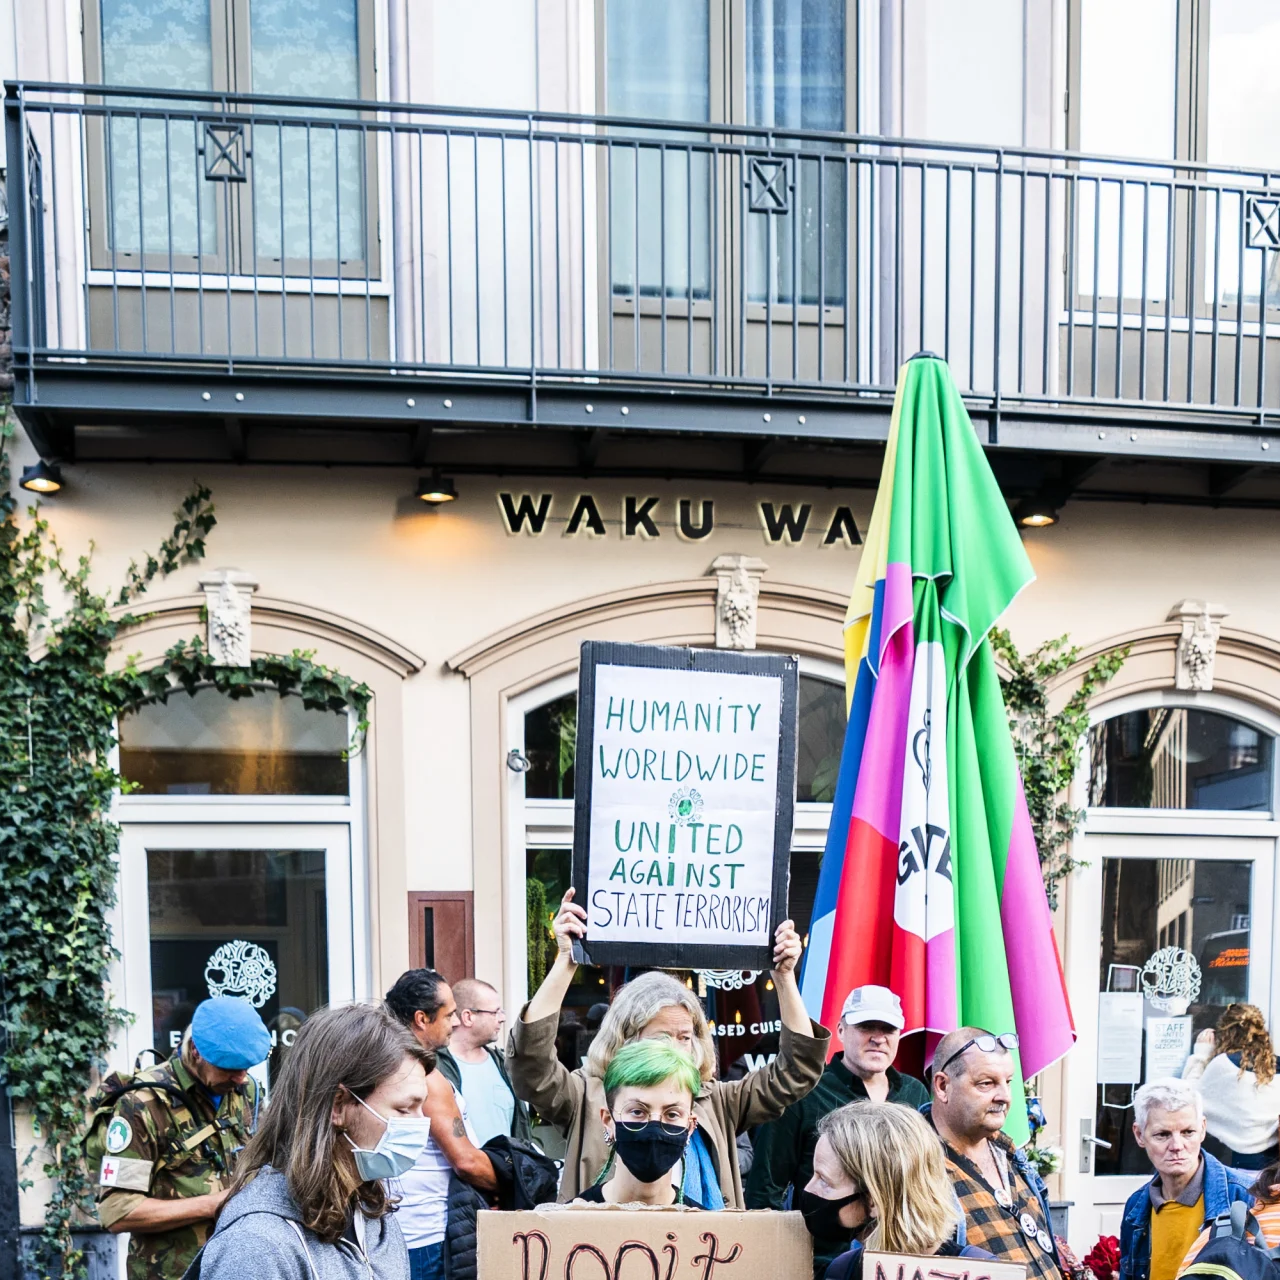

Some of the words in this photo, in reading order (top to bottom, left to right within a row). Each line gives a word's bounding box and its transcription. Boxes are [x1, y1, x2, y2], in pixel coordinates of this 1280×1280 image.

[499, 493, 714, 540] WAKU
[761, 502, 864, 546] WA
[599, 745, 766, 782] WORLDWIDE
[614, 819, 744, 855] UNITED
[609, 856, 745, 890] AGAINST
[592, 889, 667, 930] STATE
[674, 893, 770, 933] TERRORISM
